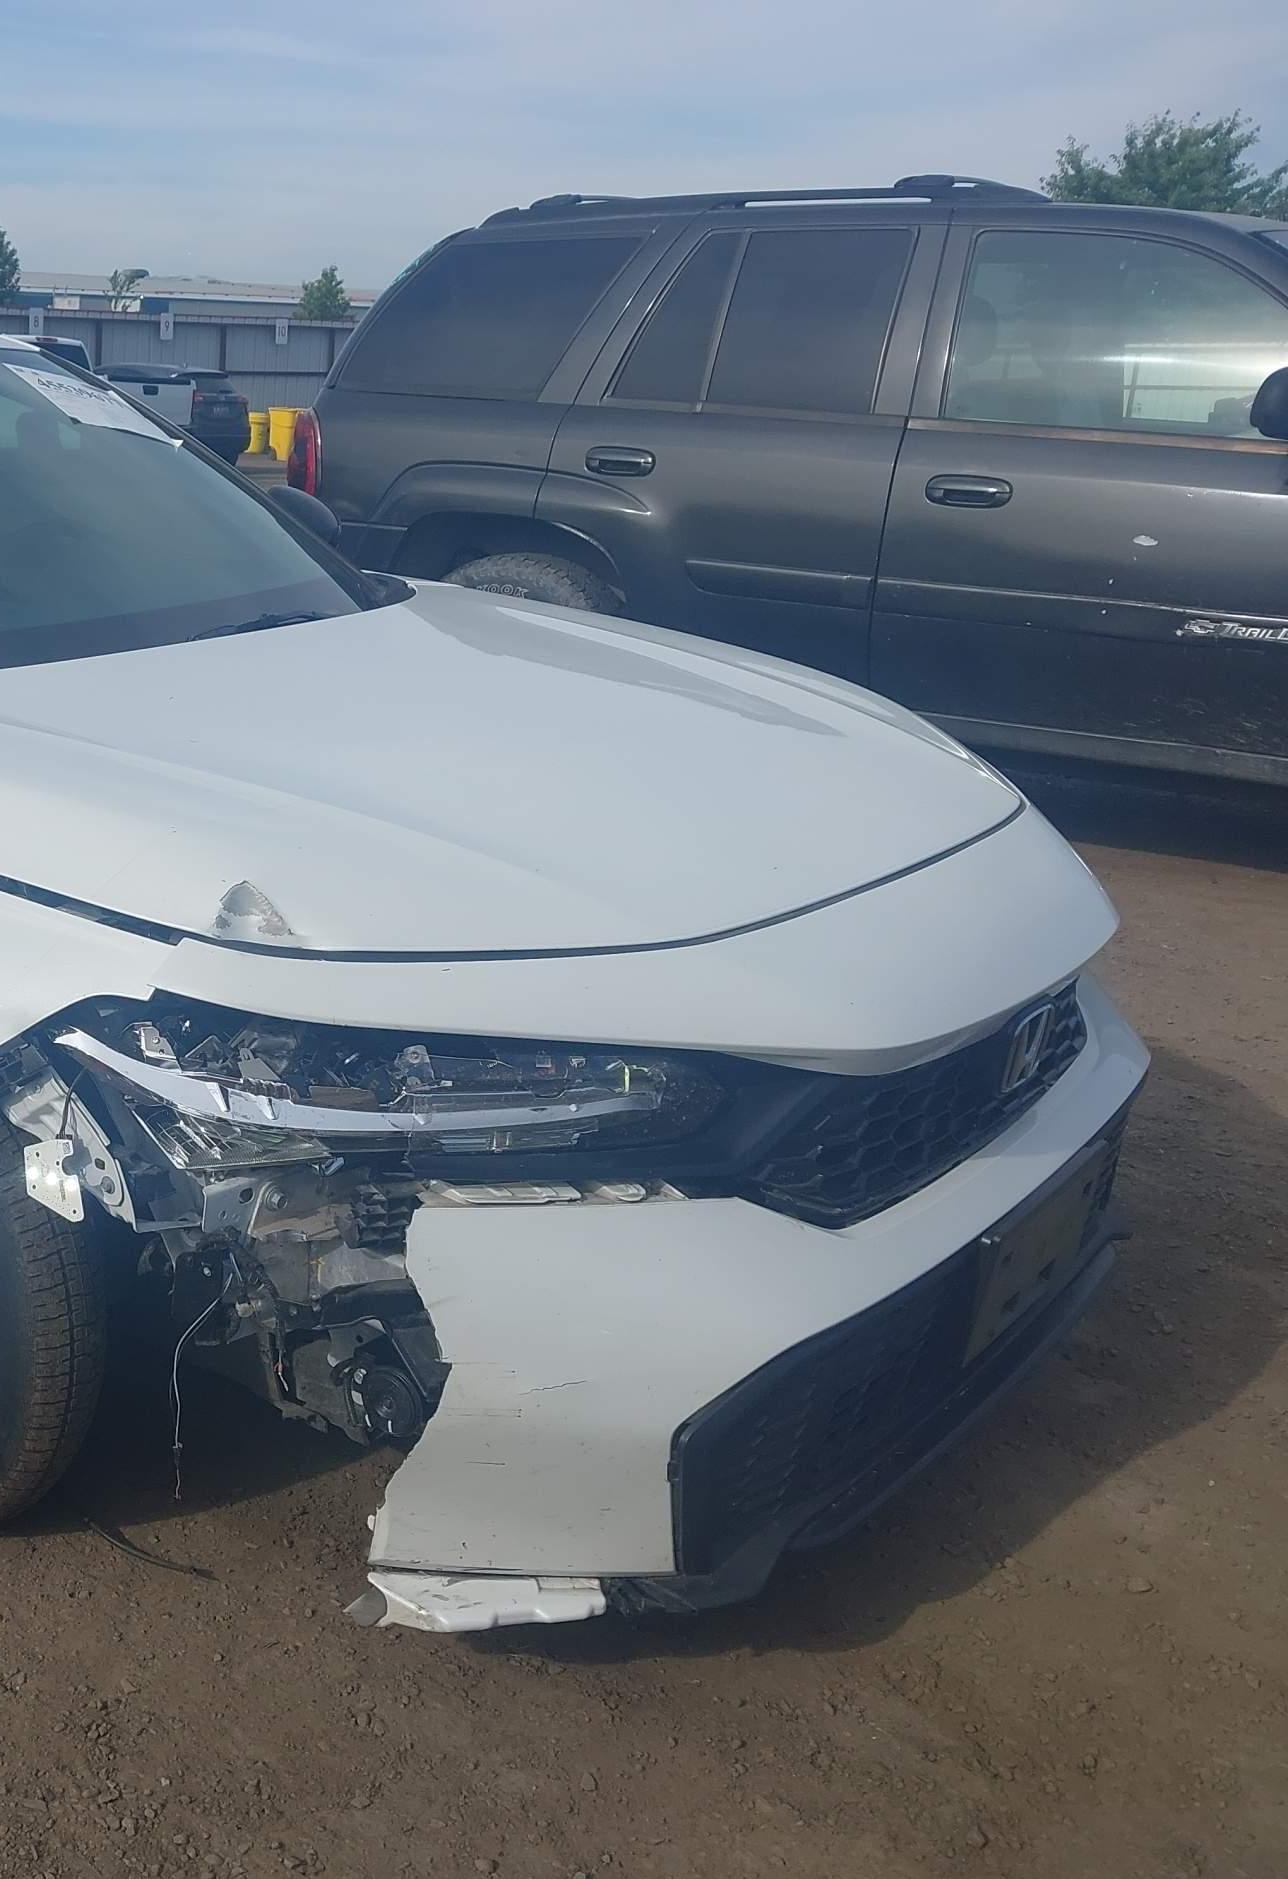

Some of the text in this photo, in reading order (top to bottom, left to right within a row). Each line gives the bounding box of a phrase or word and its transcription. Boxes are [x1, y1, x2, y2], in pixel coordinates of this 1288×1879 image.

[33, 315, 40, 328] 8
[164, 320, 170, 331] 9
[278, 325, 287, 337] 10
